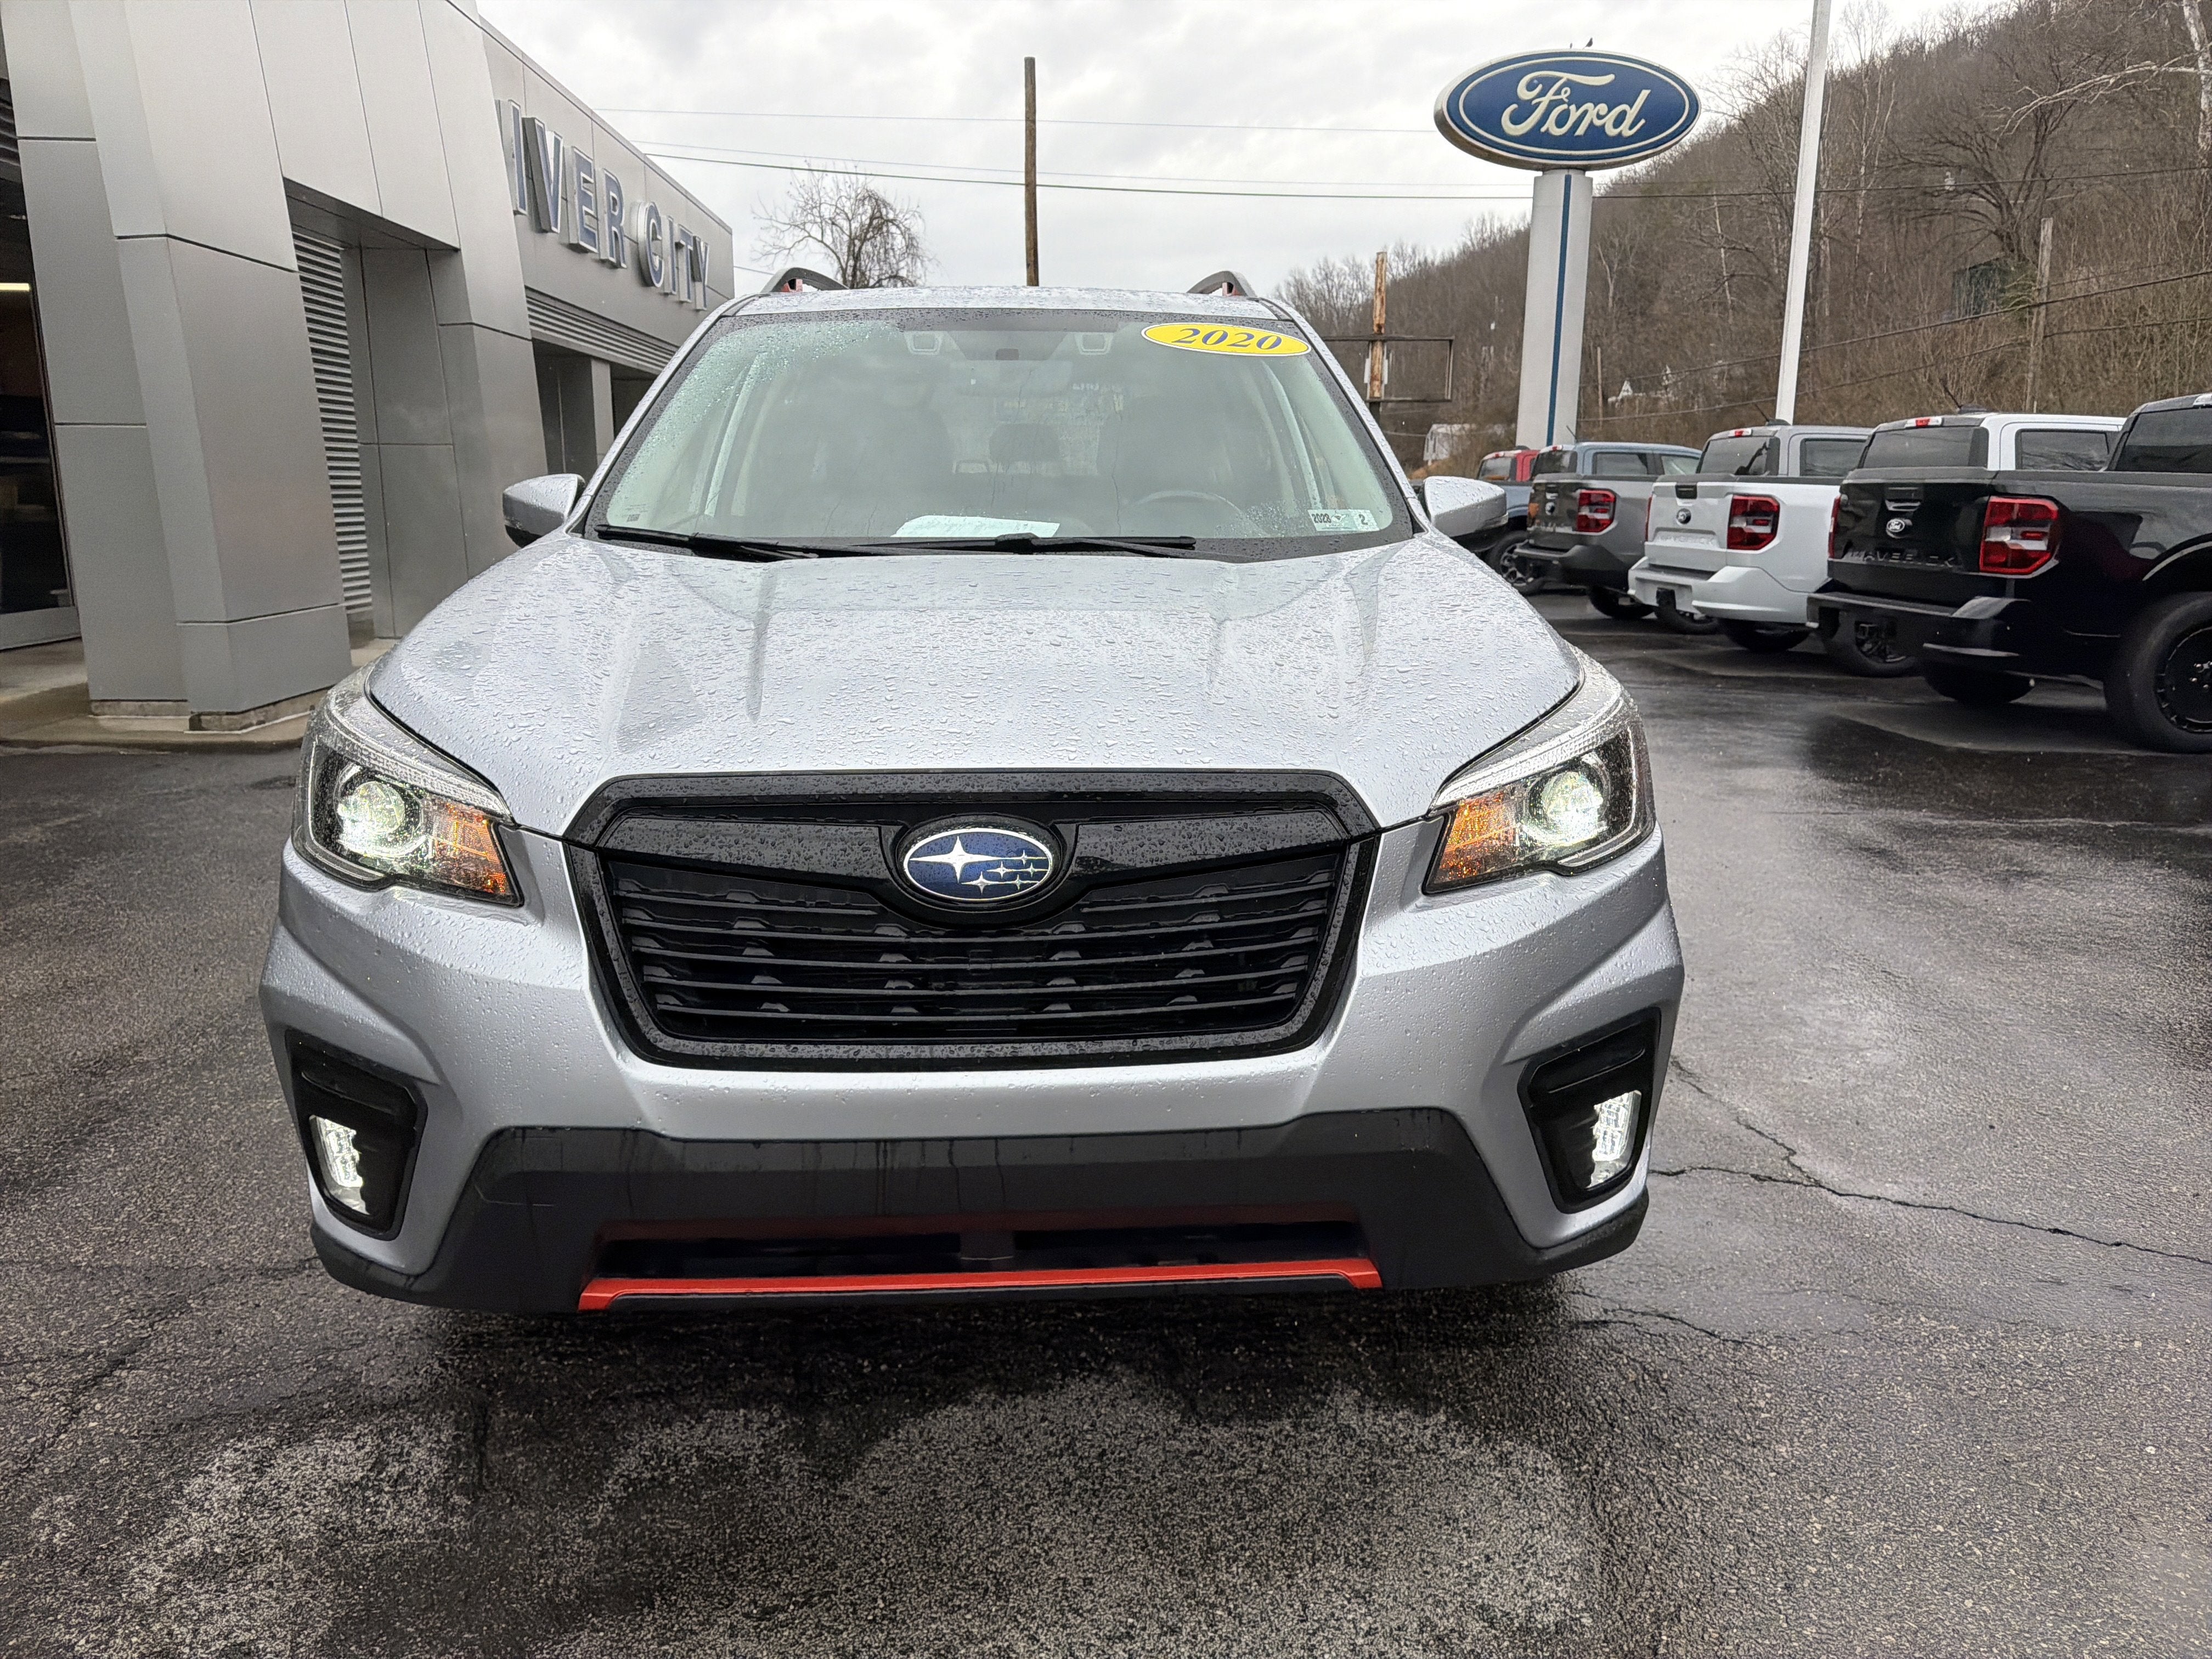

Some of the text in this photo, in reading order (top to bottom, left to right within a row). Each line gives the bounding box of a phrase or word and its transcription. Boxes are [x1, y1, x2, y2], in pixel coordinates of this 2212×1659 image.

[1501, 70, 1651, 138] Ford
[632, 201, 709, 311] CITY
[1171, 328, 1283, 350] 2020
[1358, 514, 1369, 526] 2
